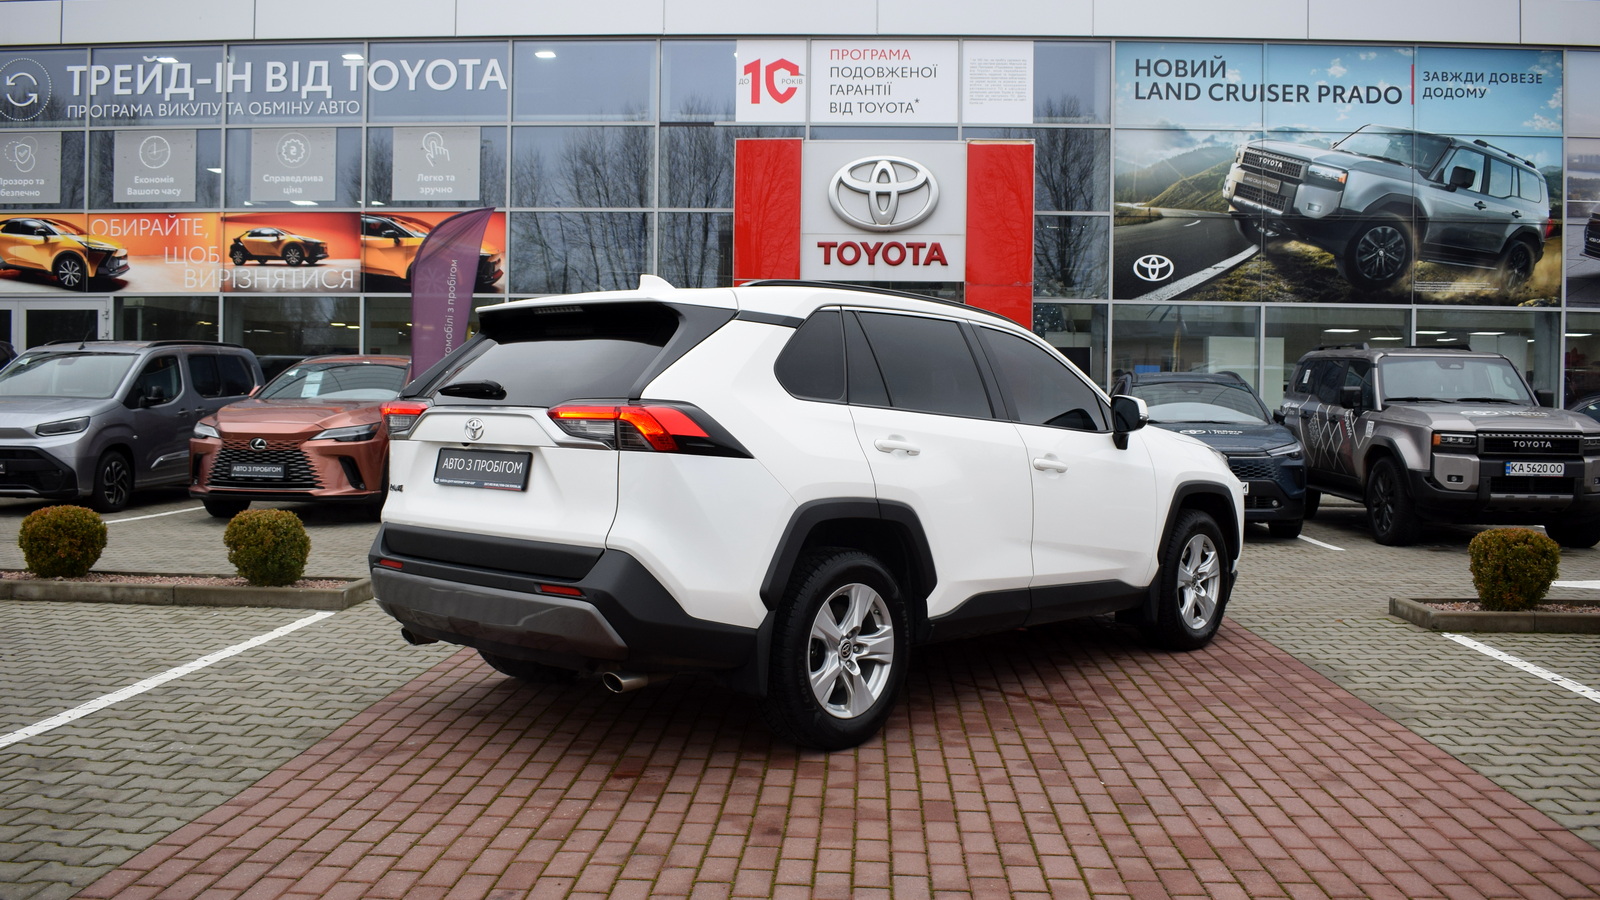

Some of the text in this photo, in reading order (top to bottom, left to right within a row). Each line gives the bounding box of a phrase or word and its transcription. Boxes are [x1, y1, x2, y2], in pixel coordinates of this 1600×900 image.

[829, 48, 912, 61] ПРОГРАМА
[829, 63, 938, 80] ПОДОВЖЕНОЇ
[1134, 55, 1227, 79] НОВИЙ
[66, 55, 508, 101] ТРЕЙД-ІН ВІД TOYOTA
[738, 78, 750, 86] ДО
[781, 78, 804, 86] РОКІВ
[1422, 71, 1543, 86] ЗАВЖДИ ДОВЕЗЕ
[829, 81, 893, 96] ГАРАНТІЇ
[1134, 81, 1403, 105] LAND CRUISER PRADO
[1422, 87, 1487, 101] ДОДОМУ
[67, 100, 361, 118] ПРОГРАМА ВИКУПУ ТА ОБМІНУ АВТО
[829, 101, 853, 116] ВІД
[1259, 157, 1283, 169] TOYOTA
[134, 175, 175, 184] Економія
[262, 174, 324, 184] Справедлива
[416, 173, 455, 183] Легко та
[0, 188, 41, 197] безпечно
[127, 187, 182, 197] Вашого часу
[282, 185, 303, 195] ціна
[419, 186, 453, 195] зручно
[90, 214, 209, 238] ОБИРАЙТЕ,
[164, 246, 220, 265] ЩОБ
[817, 241, 948, 266] TOYOTA
[184, 268, 355, 289] ВИРІЗНЯТИСЯ
[446, 259, 458, 305] пробігом
[1512, 440, 1552, 448] TOYOTA
[441, 457, 523, 474] АВТО З ПРОБІГОМ
[1510, 463, 1525, 473] KA
[1526, 463, 1548, 473] 5620
